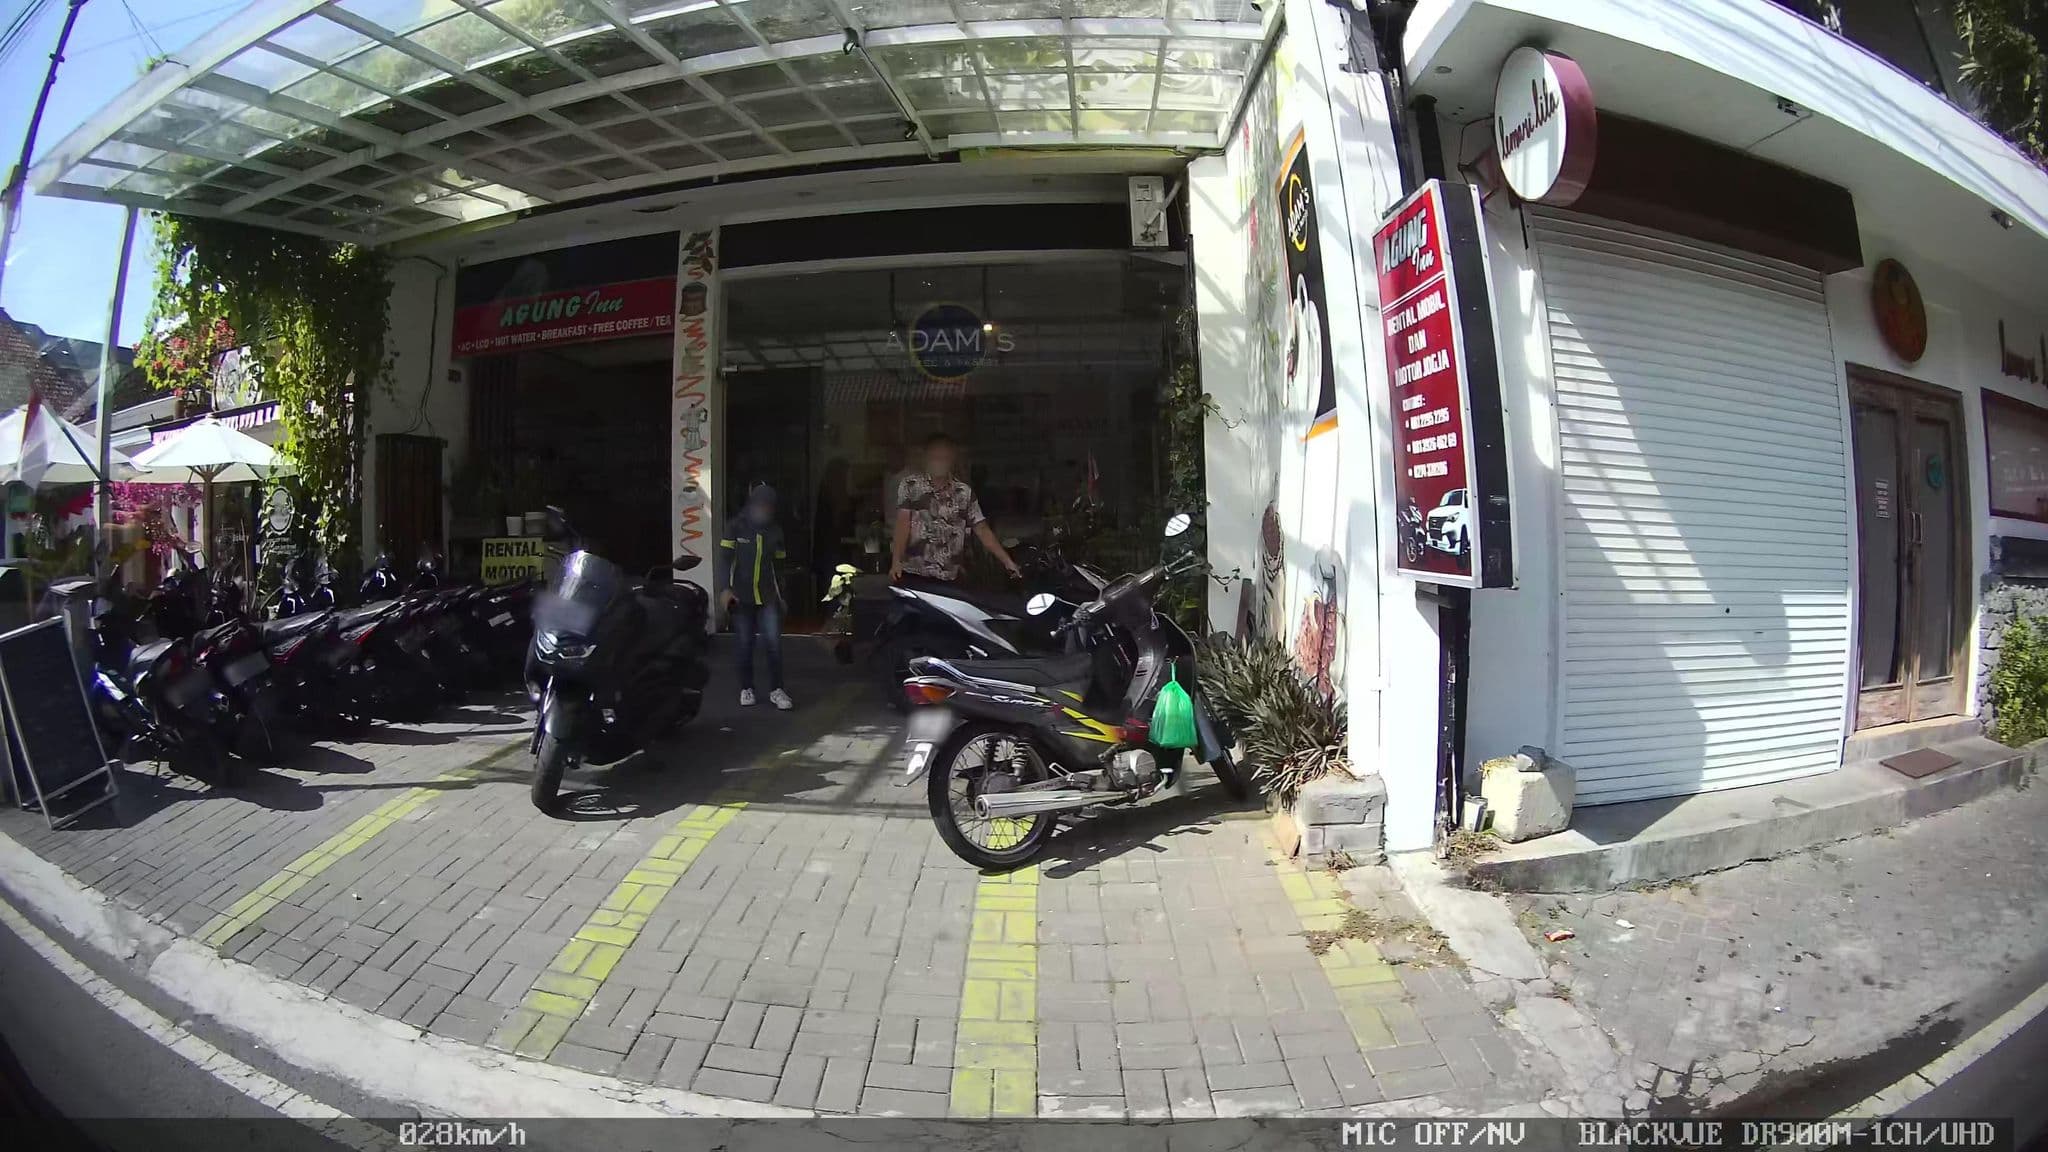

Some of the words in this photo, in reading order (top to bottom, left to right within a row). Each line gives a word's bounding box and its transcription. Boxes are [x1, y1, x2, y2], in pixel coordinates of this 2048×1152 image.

[1383, 208, 1426, 274] AGUNG
[500, 296, 580, 326] AGUNG
[584, 290, 624, 316] Inn
[1386, 304, 1418, 337] RENTAL
[1417, 290, 1446, 321] MOBIL
[495, 336, 510, 347] HOT
[511, 331, 537, 345] WATER
[542, 326, 587, 339] BREAKFAST
[592, 321, 615, 334] FREE
[616, 316, 649, 332] COFFEE
[655, 315, 672, 327] TEA
[887, 327, 1016, 352] ADAMS
[1407, 329, 1427, 354] DAN
[1394, 363, 1423, 388] MOTOR
[1422, 349, 1451, 378] JOGJA
[485, 541, 538, 557] RENTAL
